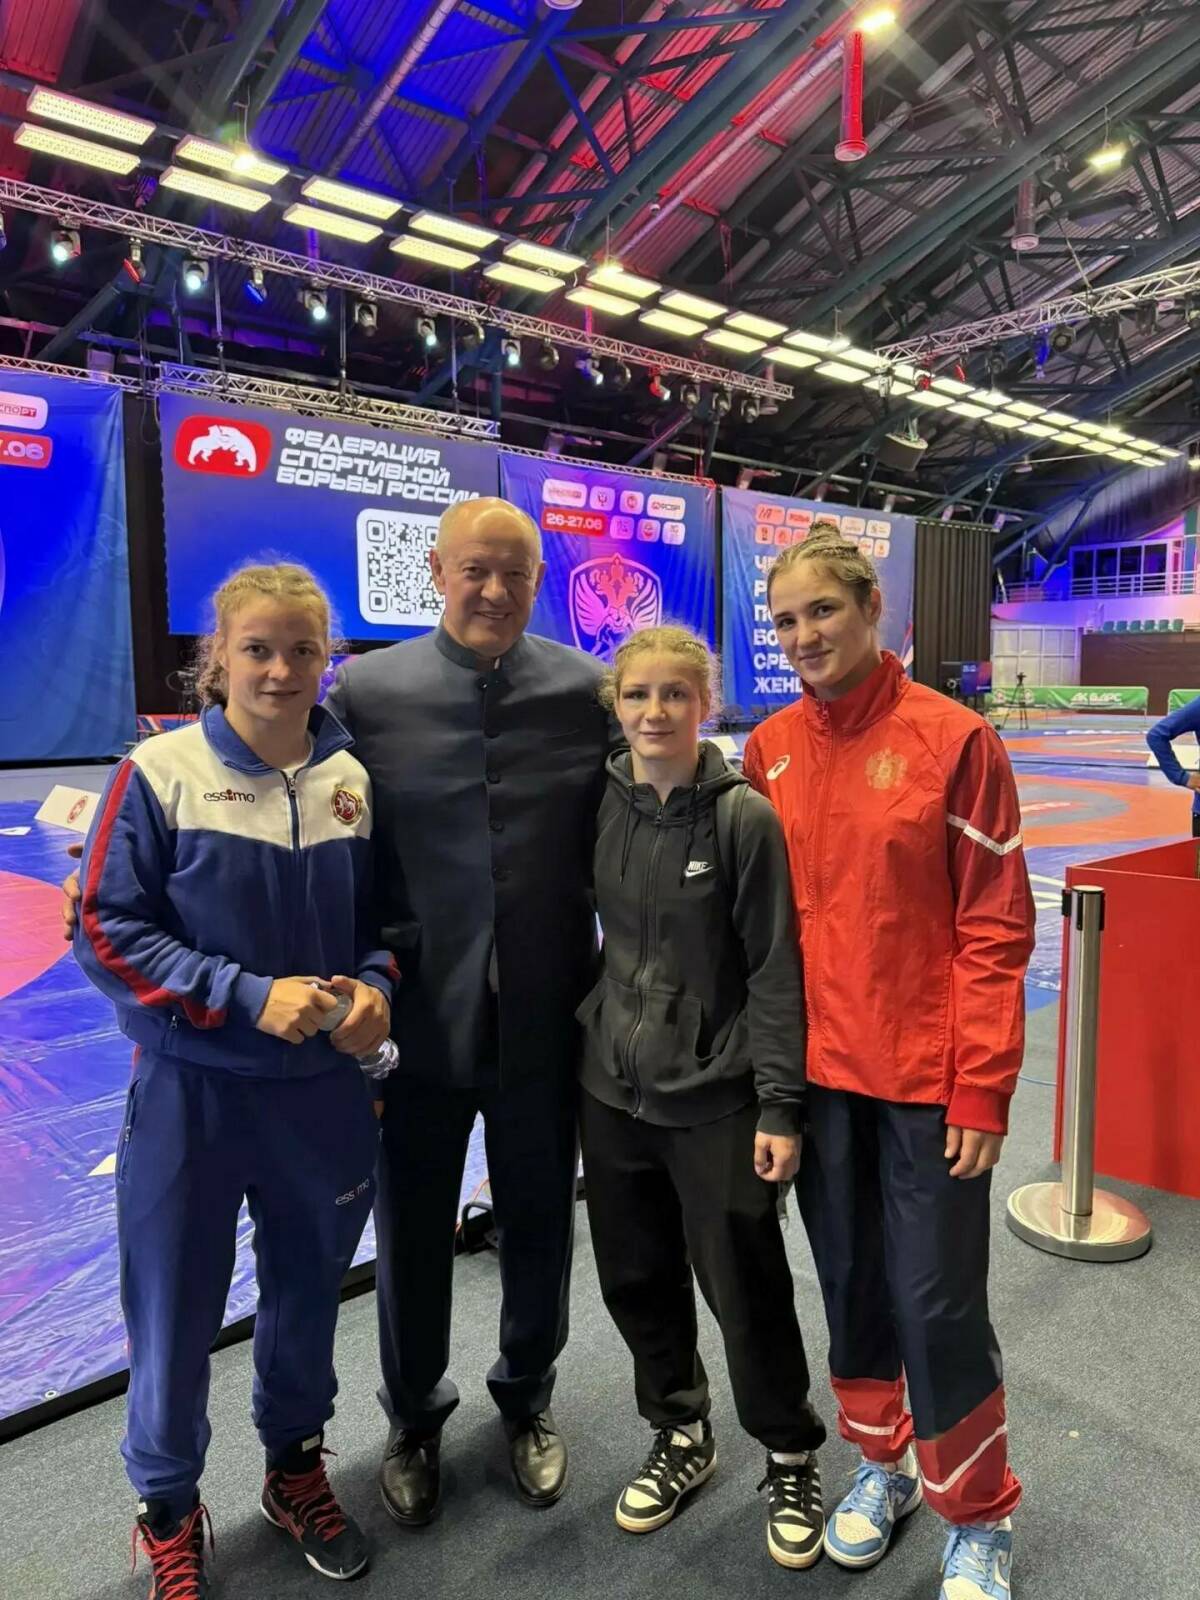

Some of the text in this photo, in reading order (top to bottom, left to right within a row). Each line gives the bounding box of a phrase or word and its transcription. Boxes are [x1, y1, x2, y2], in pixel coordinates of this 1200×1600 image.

[285, 427, 440, 466] ФЕДЕРАЦИЯ
[276, 465, 384, 495] БОРЬБЫ
[280, 447, 451, 487] СПОРТИВНОЙ
[546, 512, 603, 531] 26-27.06
[203, 788, 255, 803] essimo
